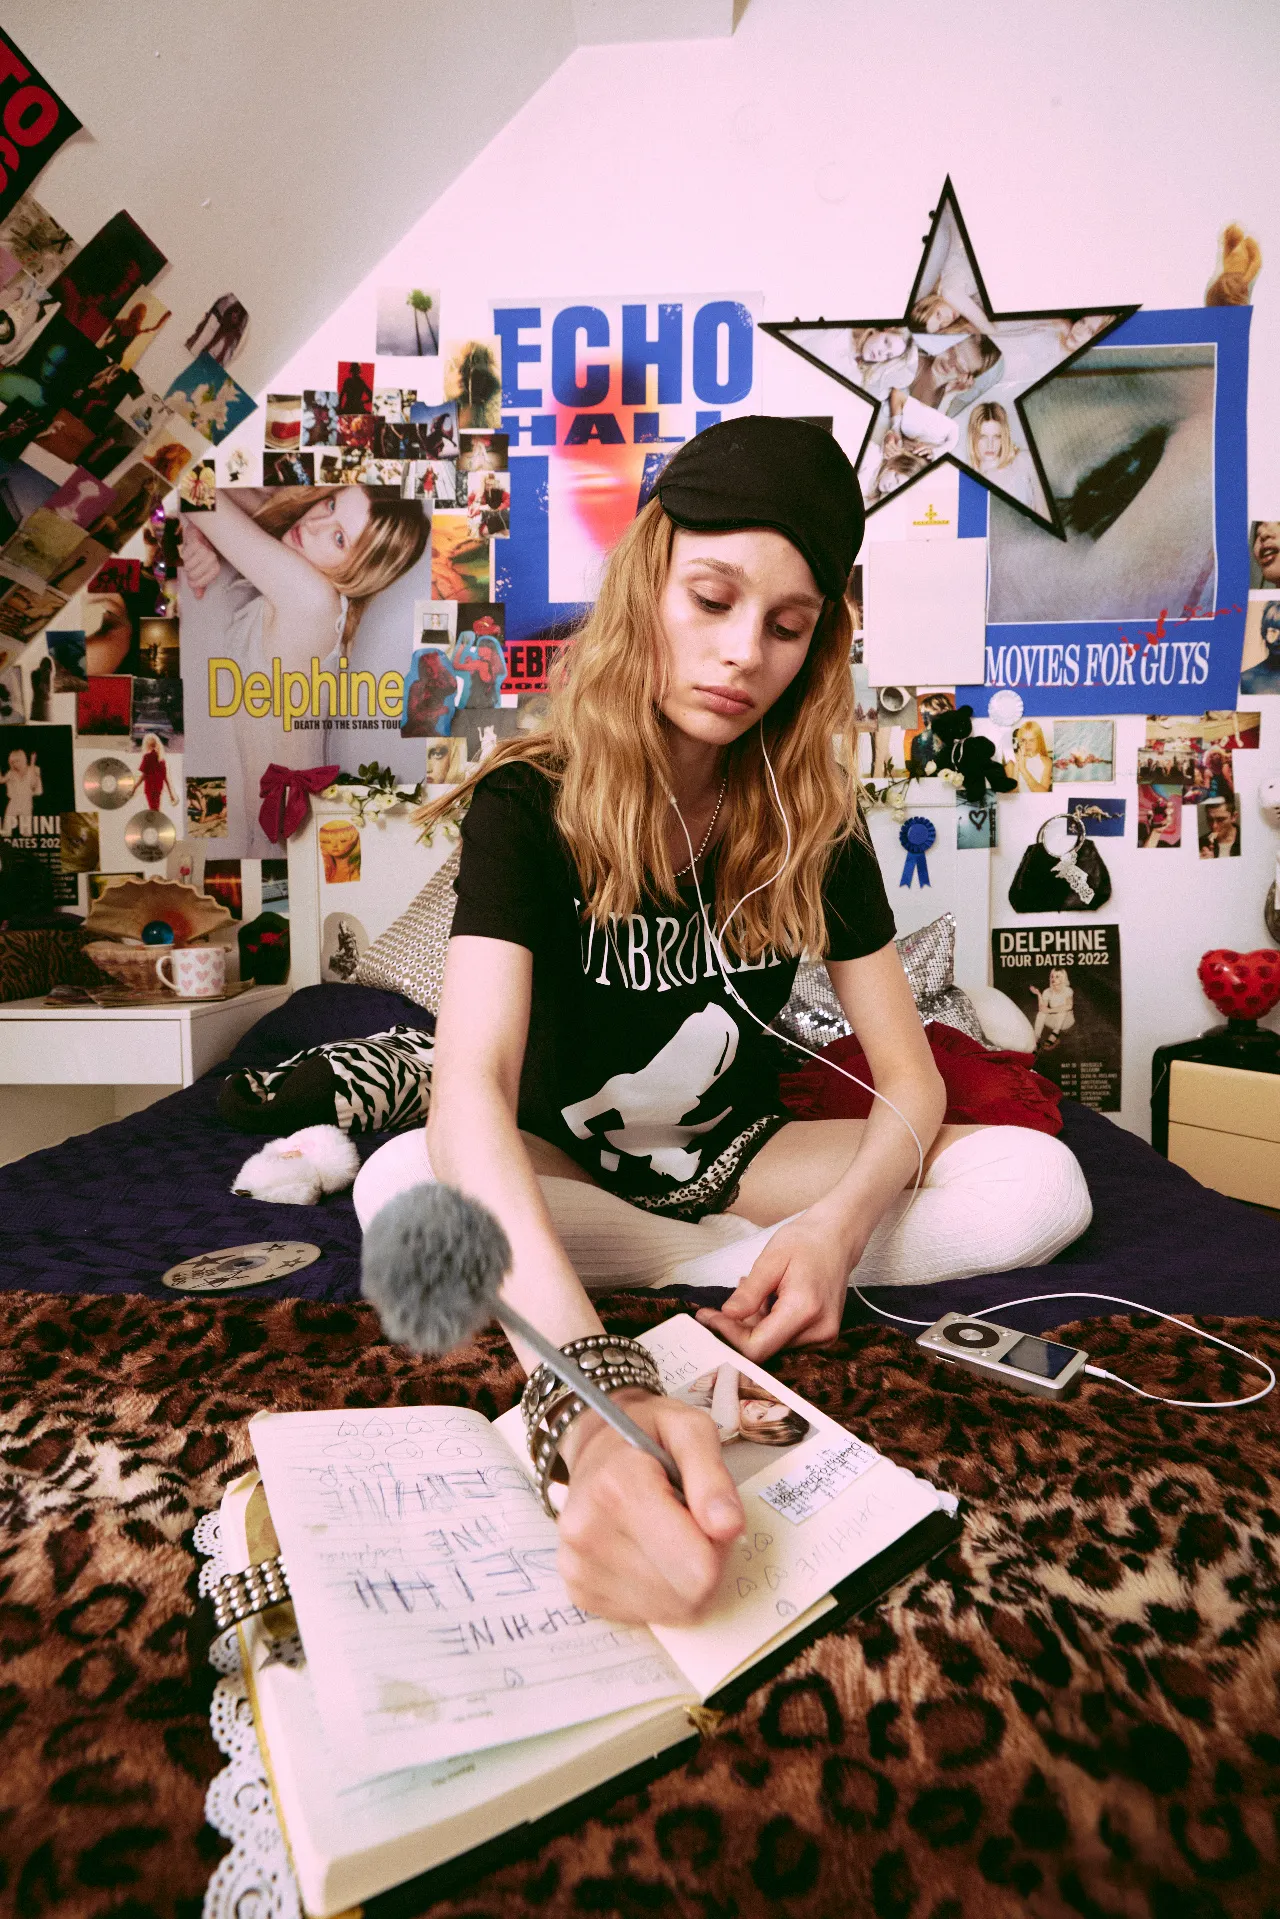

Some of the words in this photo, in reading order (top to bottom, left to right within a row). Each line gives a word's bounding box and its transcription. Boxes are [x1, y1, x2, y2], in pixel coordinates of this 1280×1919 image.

[493, 300, 753, 409] ECHO
[984, 644, 1080, 687] MOVIES
[1085, 643, 1136, 686] FOR
[1140, 641, 1211, 686] GUYS
[208, 657, 405, 732] Delphine
[294, 719, 320, 730] DEATH
[322, 719, 334, 730] TO
[335, 719, 351, 730] THE
[352, 719, 379, 730] STARS
[573, 897, 805, 993] UNBROK
[1000, 929, 1108, 953] DELPHINE
[1000, 955, 1032, 968] TOUR
[1035, 953, 1075, 967] DATES
[1078, 952, 1110, 966] 2022
